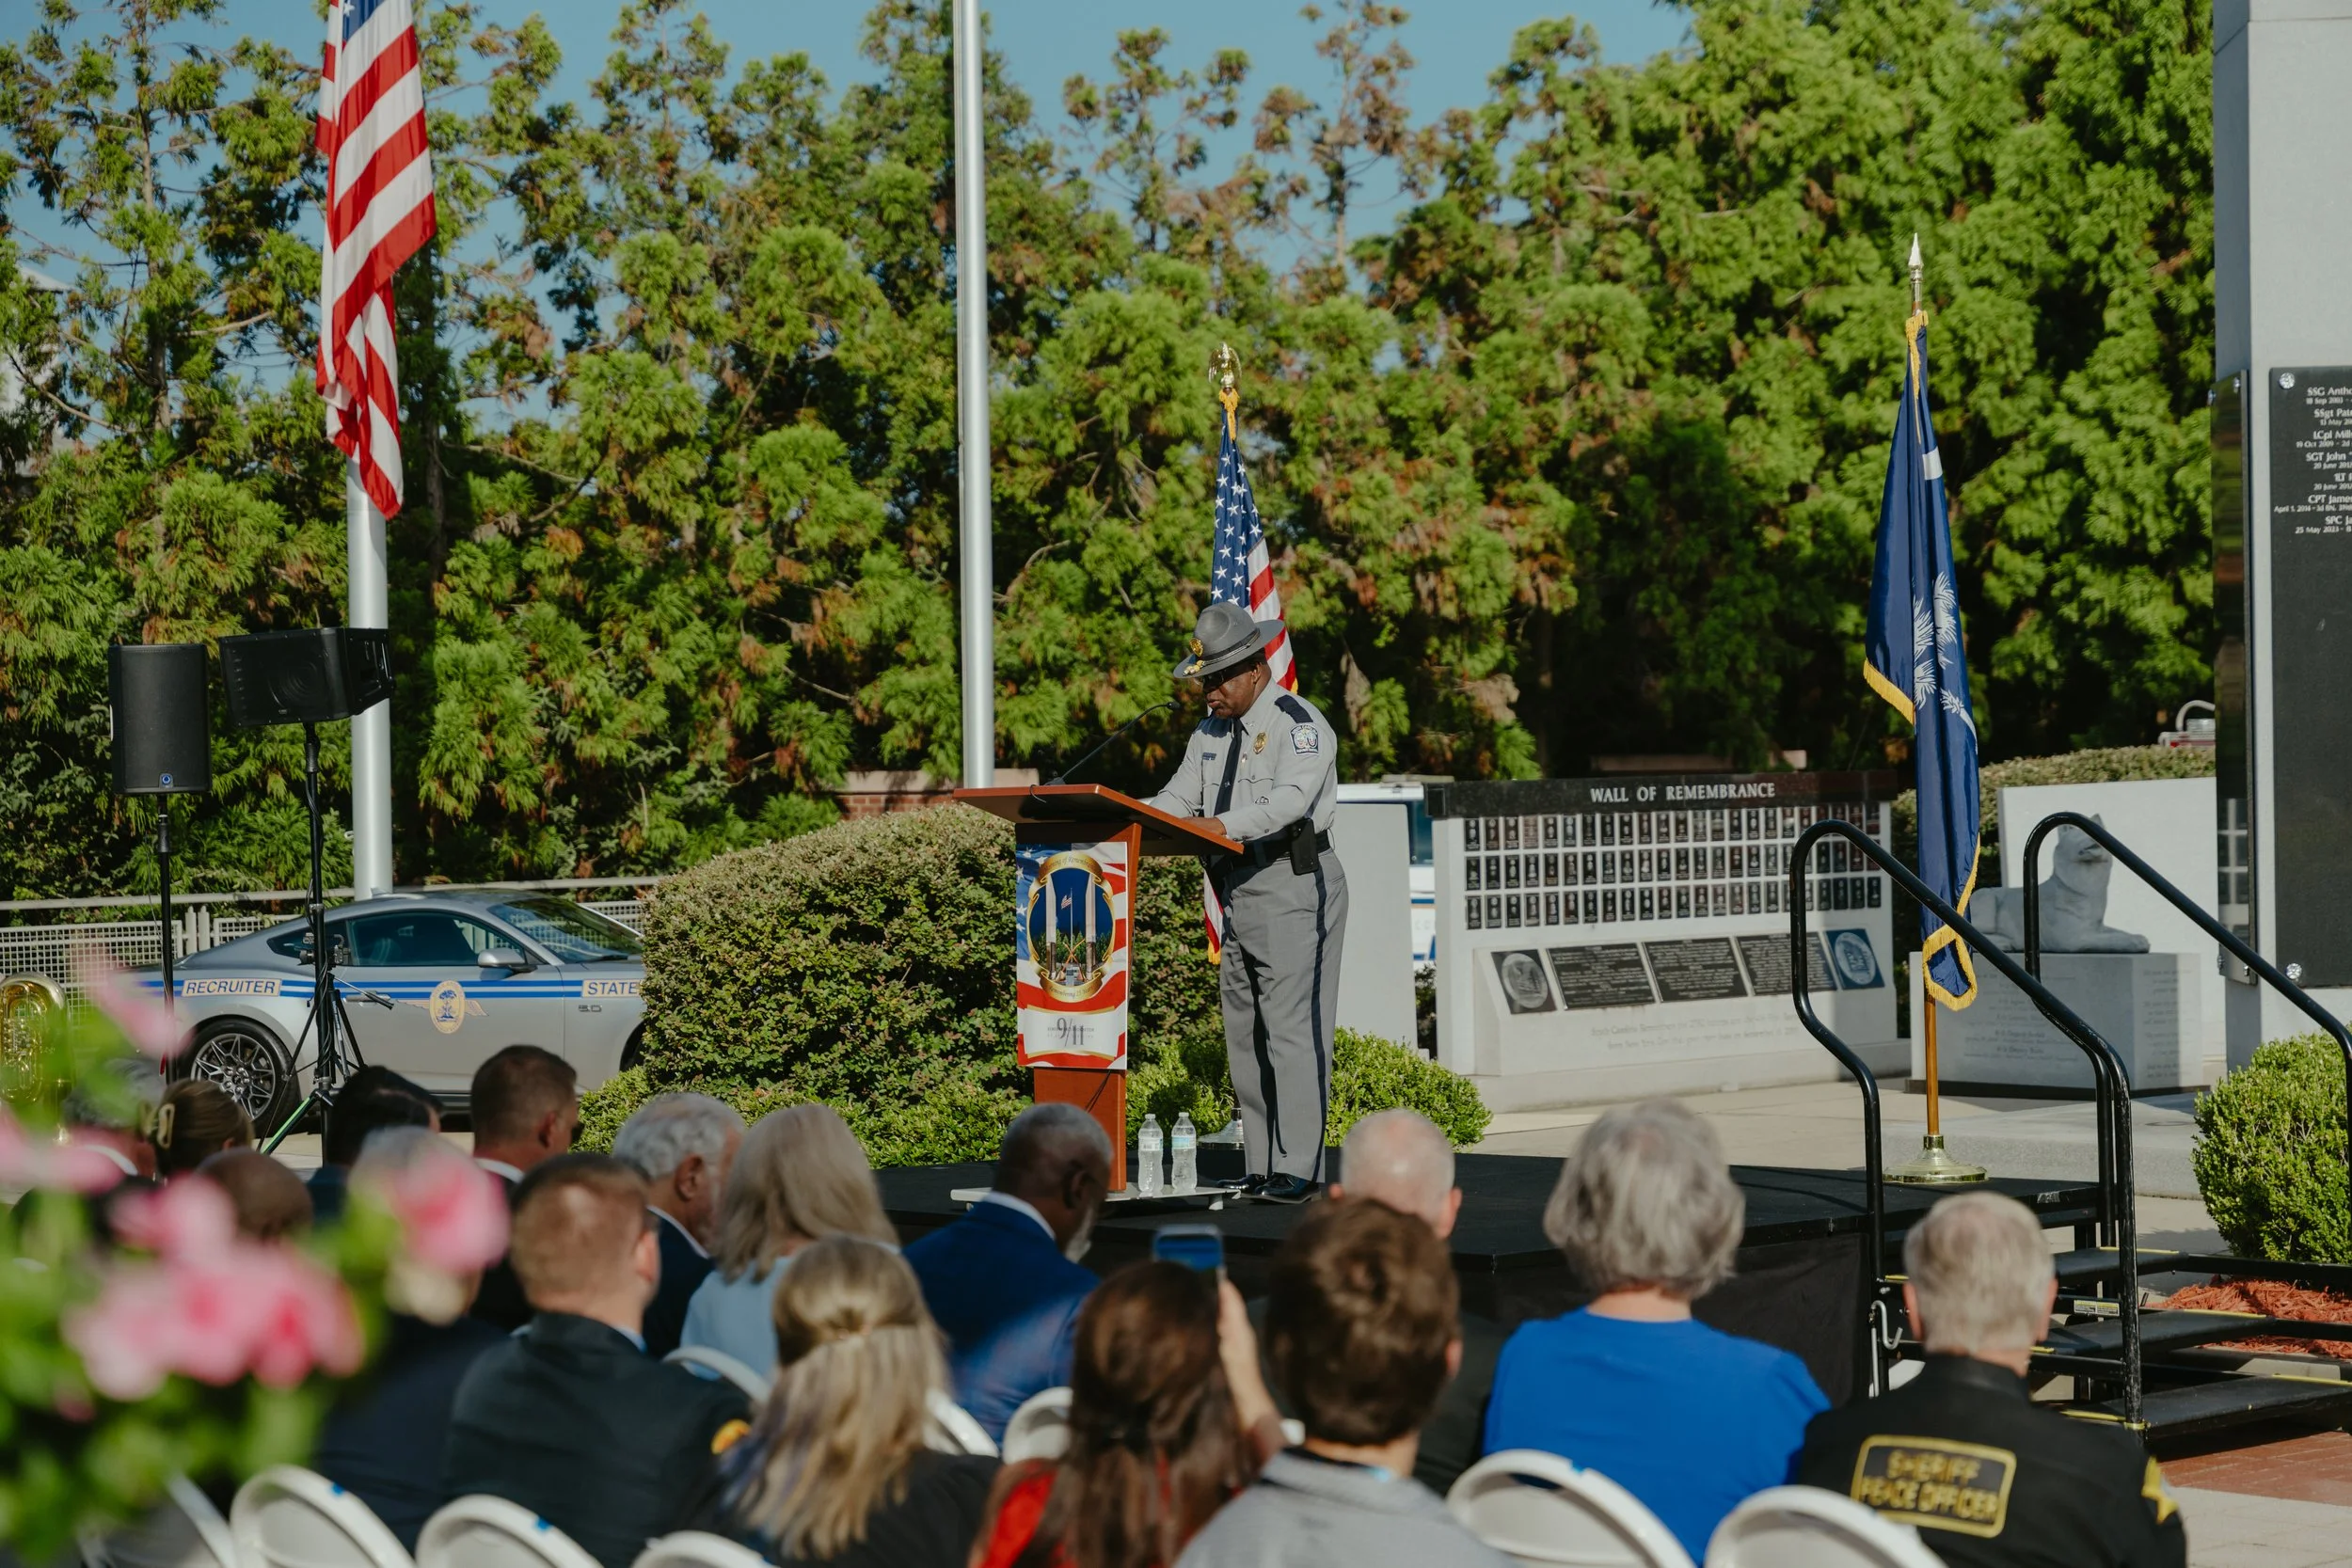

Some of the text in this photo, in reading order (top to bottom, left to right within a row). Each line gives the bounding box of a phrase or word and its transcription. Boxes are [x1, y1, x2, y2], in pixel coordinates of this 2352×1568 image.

[2307, 387, 2326, 396] SSG
[2313, 408, 2334, 420] SSgt
[2312, 430, 2332, 441] LCpl
[2306, 451, 2324, 462] SGT
[2326, 451, 2346, 462] John
[2323, 462, 2337, 470] June
[2308, 494, 2327, 503] CPT
[1590, 783, 1775, 802] WALL OF REMEMBRANCE
[186, 980, 276, 994] RECRUITER
[587, 982, 640, 995] STATE
[1057, 1018, 1084, 1047] 9/11
[1887, 1449, 1981, 1485] SHERIFF
[1860, 1476, 1999, 1520] PEACE OFFICER
